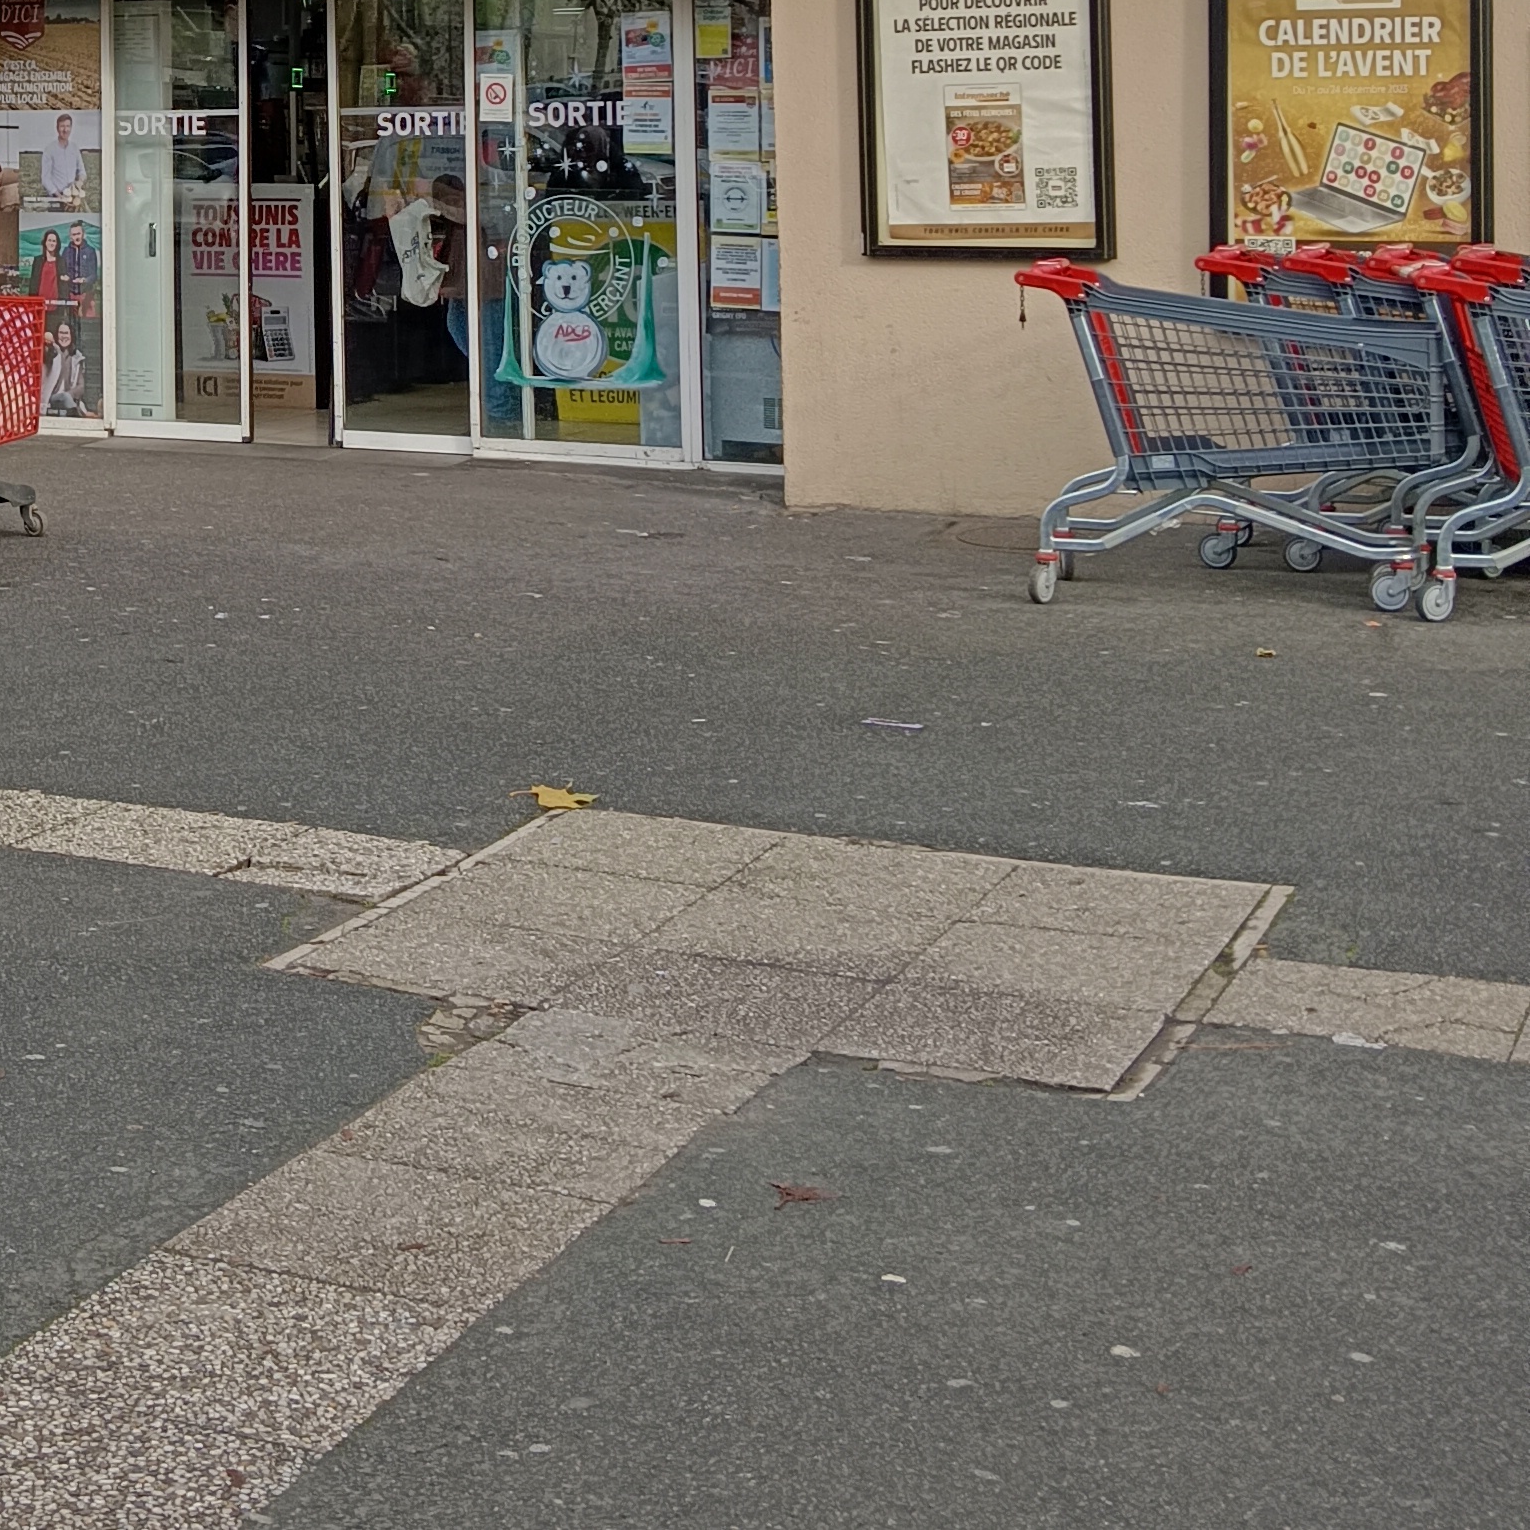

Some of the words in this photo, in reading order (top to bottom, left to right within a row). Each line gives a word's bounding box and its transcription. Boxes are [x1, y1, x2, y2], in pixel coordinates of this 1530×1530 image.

[1, 4, 40, 24] D'ICI
[894, 19, 911, 34] LA
[915, 15, 990, 33] SÉLECTION
[994, 11, 1078, 30] RÉGIONALE
[1258, 16, 1442, 46] CALENDRIER
[915, 38, 933, 54] DE
[937, 36, 984, 53] VOTRE
[988, 33, 1056, 51] MAGASIN
[911, 57, 973, 75] FLASHEZ
[976, 57, 992, 72] LE
[996, 56, 1018, 73] QR
[1022, 54, 1063, 71] CODE
[1271, 51, 1309, 79] DE
[1317, 49, 1432, 78] L'AVENT
[30, 70, 72, 82] ENSEMBLE
[13, 82, 73, 92] ALIMENTATION
[1342, 84, 1386, 94] décembre
[17, 93, 48, 104] LOCALE
[118, 113, 207, 136] SORTIE
[527, 100, 633, 128] SORTIE
[250, 204, 299, 226] UNIS
[624, 204, 676, 219] WEEK-E
[191, 227, 270, 249] CONRE
[275, 228, 301, 249] LA
[192, 250, 226, 271] VIE
[196, 376, 218, 397] ICI
[570, 387, 585, 403] ET
[589, 388, 640, 406] LEGUM
